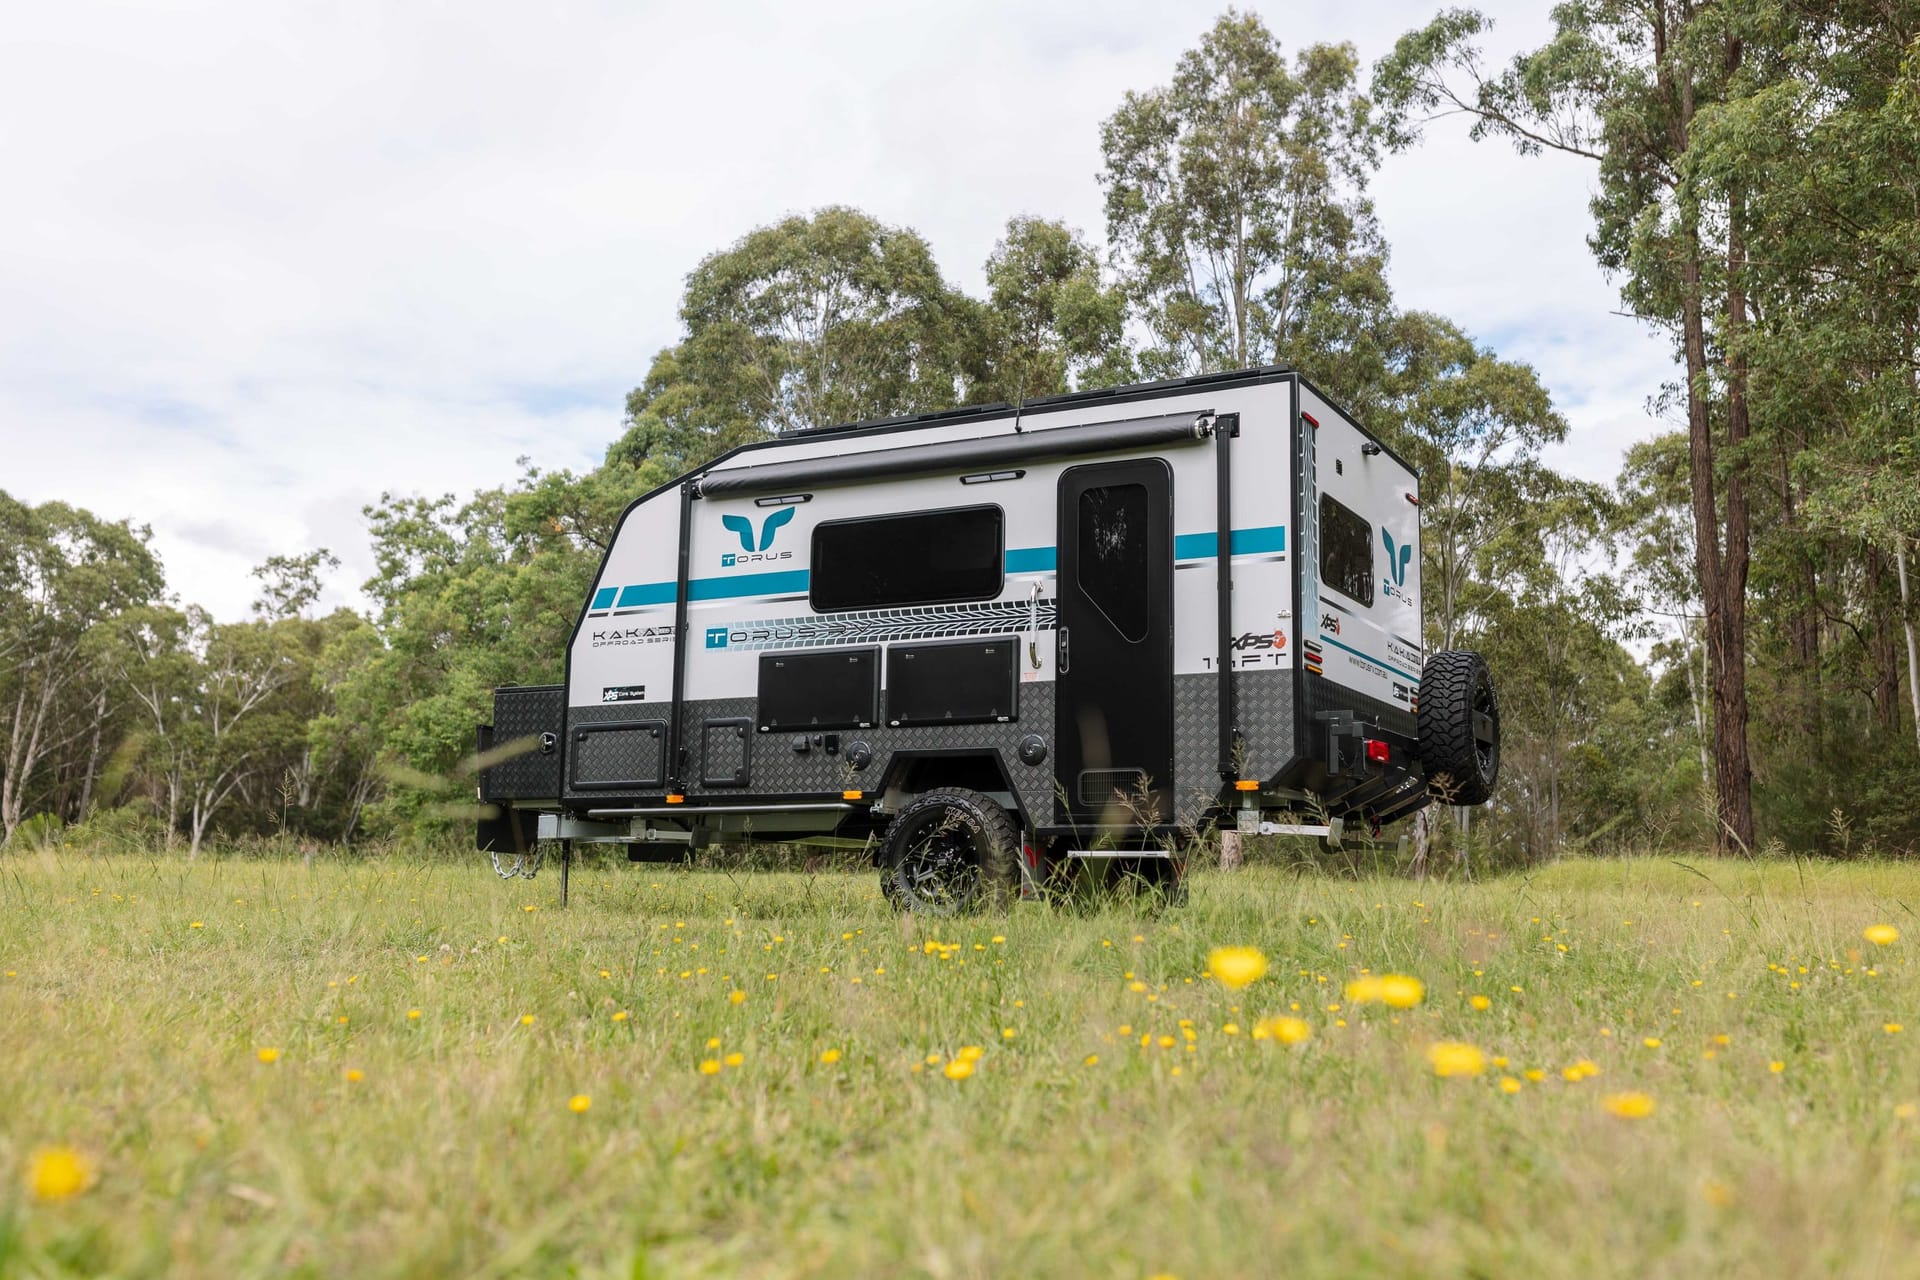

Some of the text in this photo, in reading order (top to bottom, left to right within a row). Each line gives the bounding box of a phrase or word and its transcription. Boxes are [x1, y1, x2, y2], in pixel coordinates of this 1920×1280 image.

[722, 551, 793, 567] TORUS
[592, 626, 676, 641] KAKAD
[646, 636, 676, 644] SERI
[706, 627, 816, 649] TORUS
[1230, 632, 1276, 650] XPS
[1202, 652, 1287, 670] 1FT
